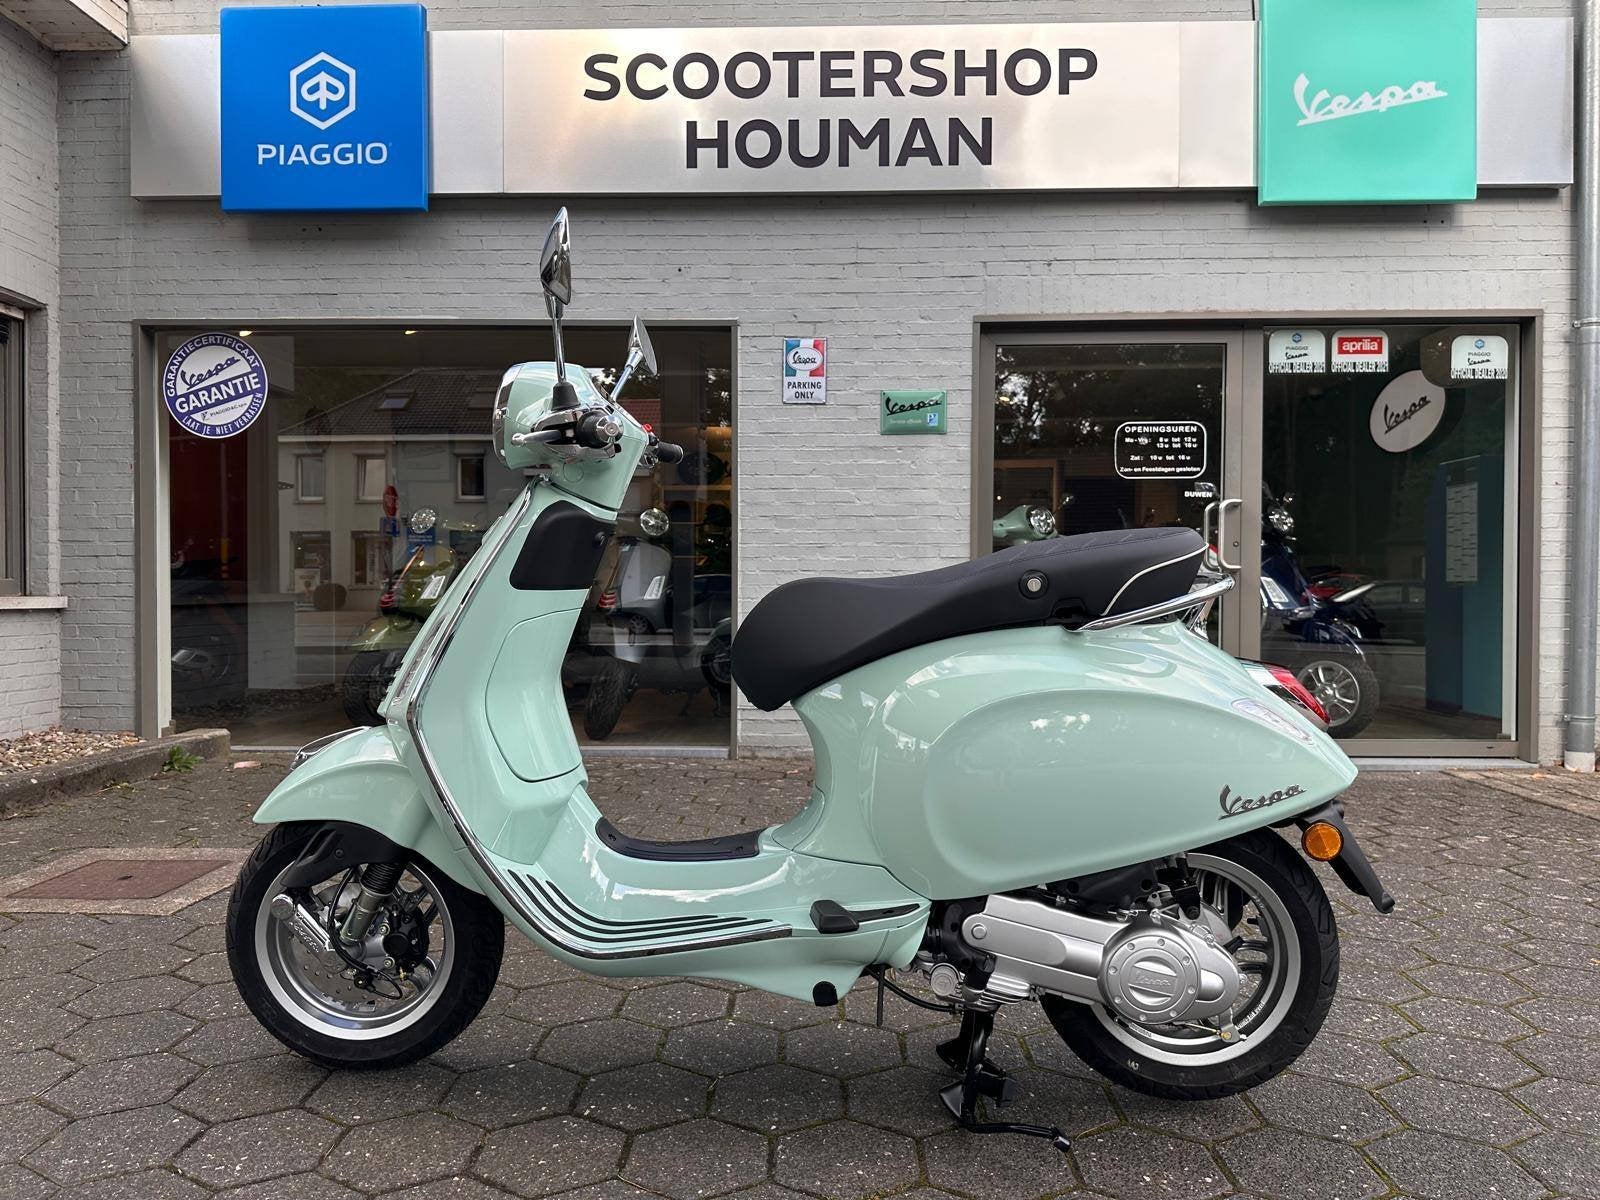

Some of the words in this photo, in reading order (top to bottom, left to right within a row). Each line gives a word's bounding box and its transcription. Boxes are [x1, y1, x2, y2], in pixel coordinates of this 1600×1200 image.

[583, 48, 1098, 101] SCOOTERSHOP
[1294, 73, 1448, 127] Vespa
[257, 142, 388, 165] PIAGGIO
[686, 117, 992, 169] HOUMAN
[792, 350, 817, 365] Vespa
[1342, 339, 1379, 353] aprilia
[167, 335, 260, 397] GARANTIECERTIFICAAT
[180, 356, 242, 391] Vespa
[1269, 361, 1292, 373] OFFICIAL
[1293, 361, 1313, 373] DEALER
[1331, 361, 1354, 373] OFFICIAL
[1355, 361, 1376, 373] DEALER
[1451, 368, 1474, 379] OFFICIAL
[1475, 368, 1495, 379] DEALER
[175, 373, 261, 413] GARANTIE
[787, 381, 822, 389] PARKING
[794, 391, 815, 399] ONLY
[182, 416, 200, 431] LAAT
[201, 426, 211, 435] JE
[215, 424, 233, 435] NIET
[234, 393, 263, 428] VERRASSEN
[885, 396, 942, 416] Vespa
[1384, 395, 1431, 434] Vespa
[1218, 784, 1308, 820] Vespa
